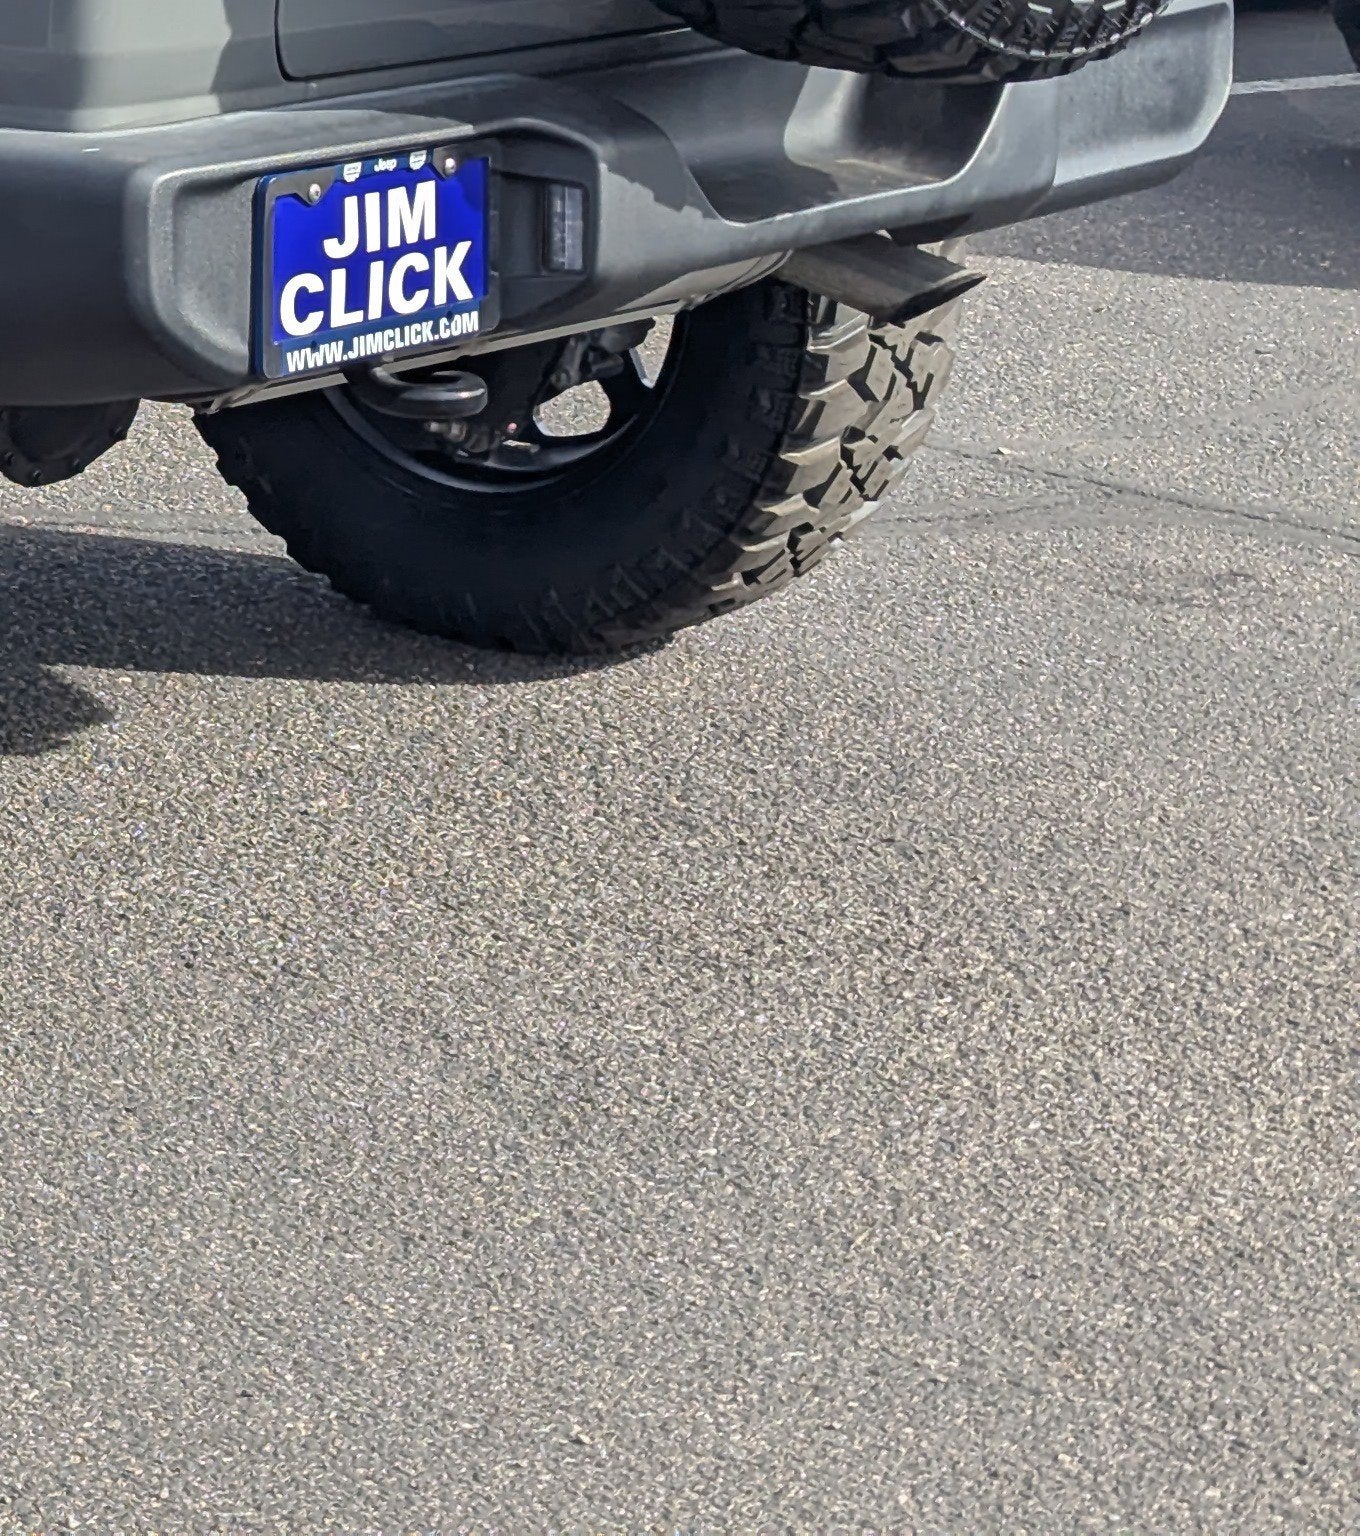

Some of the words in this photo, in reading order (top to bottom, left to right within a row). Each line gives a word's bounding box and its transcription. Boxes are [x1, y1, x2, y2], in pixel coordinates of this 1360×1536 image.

[323, 180, 437, 259] JIM
[280, 240, 474, 337] CLICK
[286, 310, 479, 372] WWW.JIMCLICK.COM
